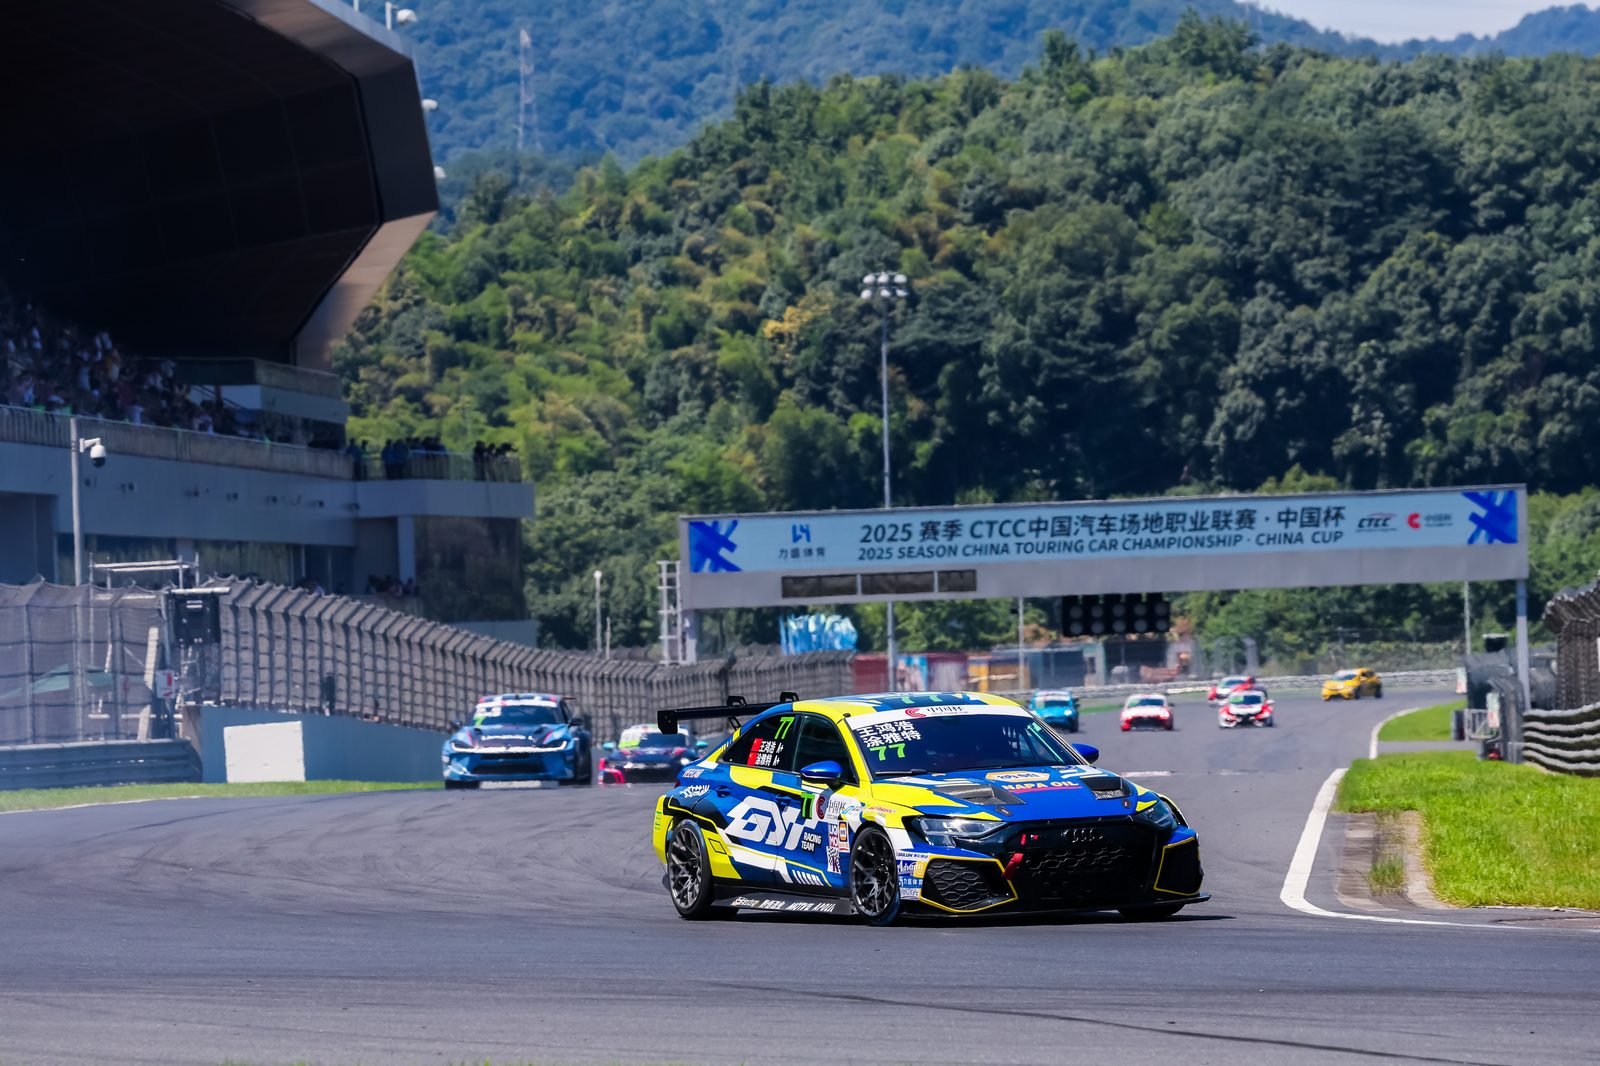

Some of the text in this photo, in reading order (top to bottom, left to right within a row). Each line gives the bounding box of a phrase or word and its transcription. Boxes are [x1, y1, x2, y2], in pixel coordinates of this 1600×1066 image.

[860, 523, 913, 543] 2025
[919, 519, 963, 542] 赛季
[858, 531, 1344, 561] 2025 SEASON CHINA TOURING CAR CHAMPIONSHIP CHINA CUP
[774, 716, 795, 740] 77
[857, 721, 915, 738] 王鸿浩
[863, 730, 922, 748] 涂雅特
[869, 743, 906, 761] 77
[1001, 782, 1049, 791] NAPA
[800, 792, 816, 820] 77
[801, 840, 815, 852] TEAM
[803, 832, 822, 845] RACING
